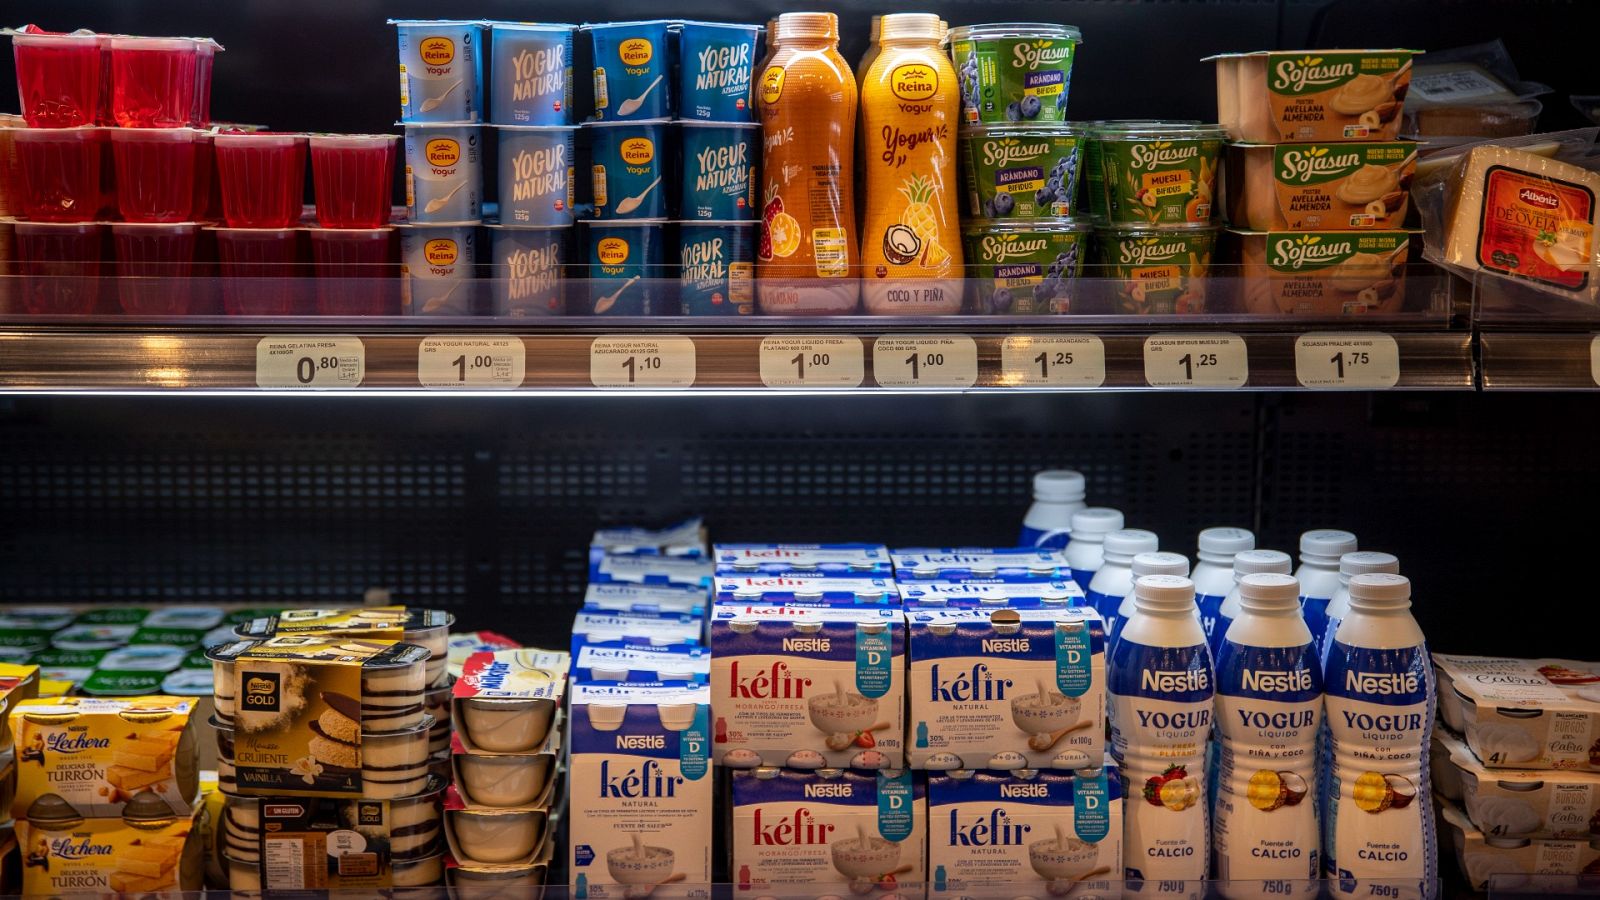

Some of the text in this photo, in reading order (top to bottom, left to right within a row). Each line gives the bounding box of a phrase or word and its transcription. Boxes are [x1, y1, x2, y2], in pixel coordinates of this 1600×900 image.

[424, 50, 451, 60] Reina
[512, 43, 564, 77] YOGUR
[624, 51, 649, 60] Reina
[698, 43, 750, 73] YOGUR
[1013, 38, 1069, 70] Sojasun
[426, 67, 451, 76] Yogur
[624, 67, 650, 76] Yogur
[696, 66, 750, 91] NATURAL
[1274, 59, 1354, 92] Sojasun
[513, 73, 564, 102] NATURAL
[897, 81, 933, 93] Reina
[1036, 85, 1057, 95] BIFIDUS
[898, 103, 933, 116] Yogur
[1284, 105, 1324, 114] AVELLANA
[1282, 113, 1324, 123] ALMENDRA
[882, 126, 938, 153] Yogur
[430, 150, 456, 160] Reina
[624, 150, 650, 160] Reina
[697, 143, 747, 173] YOGUR
[983, 140, 1049, 166] Sojasun
[1131, 143, 1198, 170] Sojasun
[513, 144, 565, 177] YOGUR
[1282, 150, 1359, 182] Sojasun
[431, 168, 456, 177] Yogur
[626, 166, 651, 176] Yogur
[696, 166, 748, 192] NATURAL
[1151, 173, 1182, 185] MUESLI
[513, 176, 566, 203] NATURAL
[1007, 181, 1033, 192] BIFIDUS
[1156, 184, 1181, 195] BIFIDUS
[1291, 195, 1331, 204] AVELLANA
[1520, 189, 1558, 206] Albéniz
[1290, 203, 1331, 212] ALMENDRA
[1496, 206, 1557, 232] DE OVEJA
[429, 251, 454, 260] Reina
[601, 250, 624, 260] Reina
[680, 238, 723, 265] YOGUR
[982, 237, 1047, 262] Sojasun
[1120, 240, 1186, 265] Sojasun
[1274, 239, 1351, 269] Sojasun
[508, 243, 559, 278] YOGUR
[430, 266, 455, 275] Yogur
[602, 265, 625, 274] Yogur
[680, 258, 726, 287] NATURAL
[1140, 268, 1171, 280] MUESLI
[509, 275, 559, 301] NATURAL
[1283, 281, 1324, 290] AVELLANA
[887, 287, 944, 302] COCO Y PIÑA
[1282, 289, 1323, 298] ALMENDRA
[297, 356, 339, 384] 0,80
[452, 354, 492, 382] 1,00
[622, 356, 661, 383] 1,10
[791, 353, 830, 379] 1,00
[906, 353, 944, 380] 1,00
[1035, 352, 1074, 379] 1,25
[1179, 354, 1217, 380] 1,25
[1331, 352, 1369, 379] 1,75
[783, 638, 832, 653] Nestlé
[982, 639, 1031, 653] Nestlé
[869, 653, 881, 665] D
[1067, 650, 1081, 664] D
[251, 682, 274, 690] Nestlé
[729, 661, 812, 699] kéfir
[930, 663, 1013, 703] kéfir
[1142, 669, 1209, 692] Nestlé
[1242, 669, 1313, 692] Nestlé
[1346, 670, 1420, 695] Nestlé
[247, 695, 275, 706] GOLD
[1137, 710, 1210, 730] YOGUR
[1238, 710, 1314, 730] YOGUR
[1342, 711, 1421, 732] YOGUR
[1555, 721, 1586, 734] BURGOS
[1157, 731, 1196, 739] LÍQUIDO
[1258, 731, 1299, 739] LÍQUIDO
[1363, 732, 1404, 741] LÍQUIDO
[617, 736, 665, 749] Nestlé
[689, 742, 701, 753] D
[1549, 740, 1585, 753] Cabra
[238, 752, 289, 764] CRUJIENTE
[46, 769, 105, 783] TURRÓN
[243, 773, 283, 784] VAINILLA
[600, 760, 684, 799] kéfir
[805, 783, 854, 798] Nestlé
[1001, 783, 1051, 799] Nestlé
[890, 795, 903, 809] D
[1085, 796, 1099, 810] D
[1556, 793, 1586, 804] BURGOS
[1551, 812, 1584, 824] Cabra
[752, 808, 835, 846] kéfir
[948, 808, 1032, 846] kéfir
[1148, 847, 1194, 858] CALCIO
[1367, 842, 1390, 850] Fuente
[1252, 848, 1301, 859] CALCIO
[1359, 850, 1408, 862] CALCIO
[1543, 850, 1574, 862] BURGOS
[51, 875, 108, 889] TURRÓN
[1158, 881, 1185, 894] 750g
[1262, 881, 1292, 895] 750g
[1369, 885, 1399, 900] 750g
